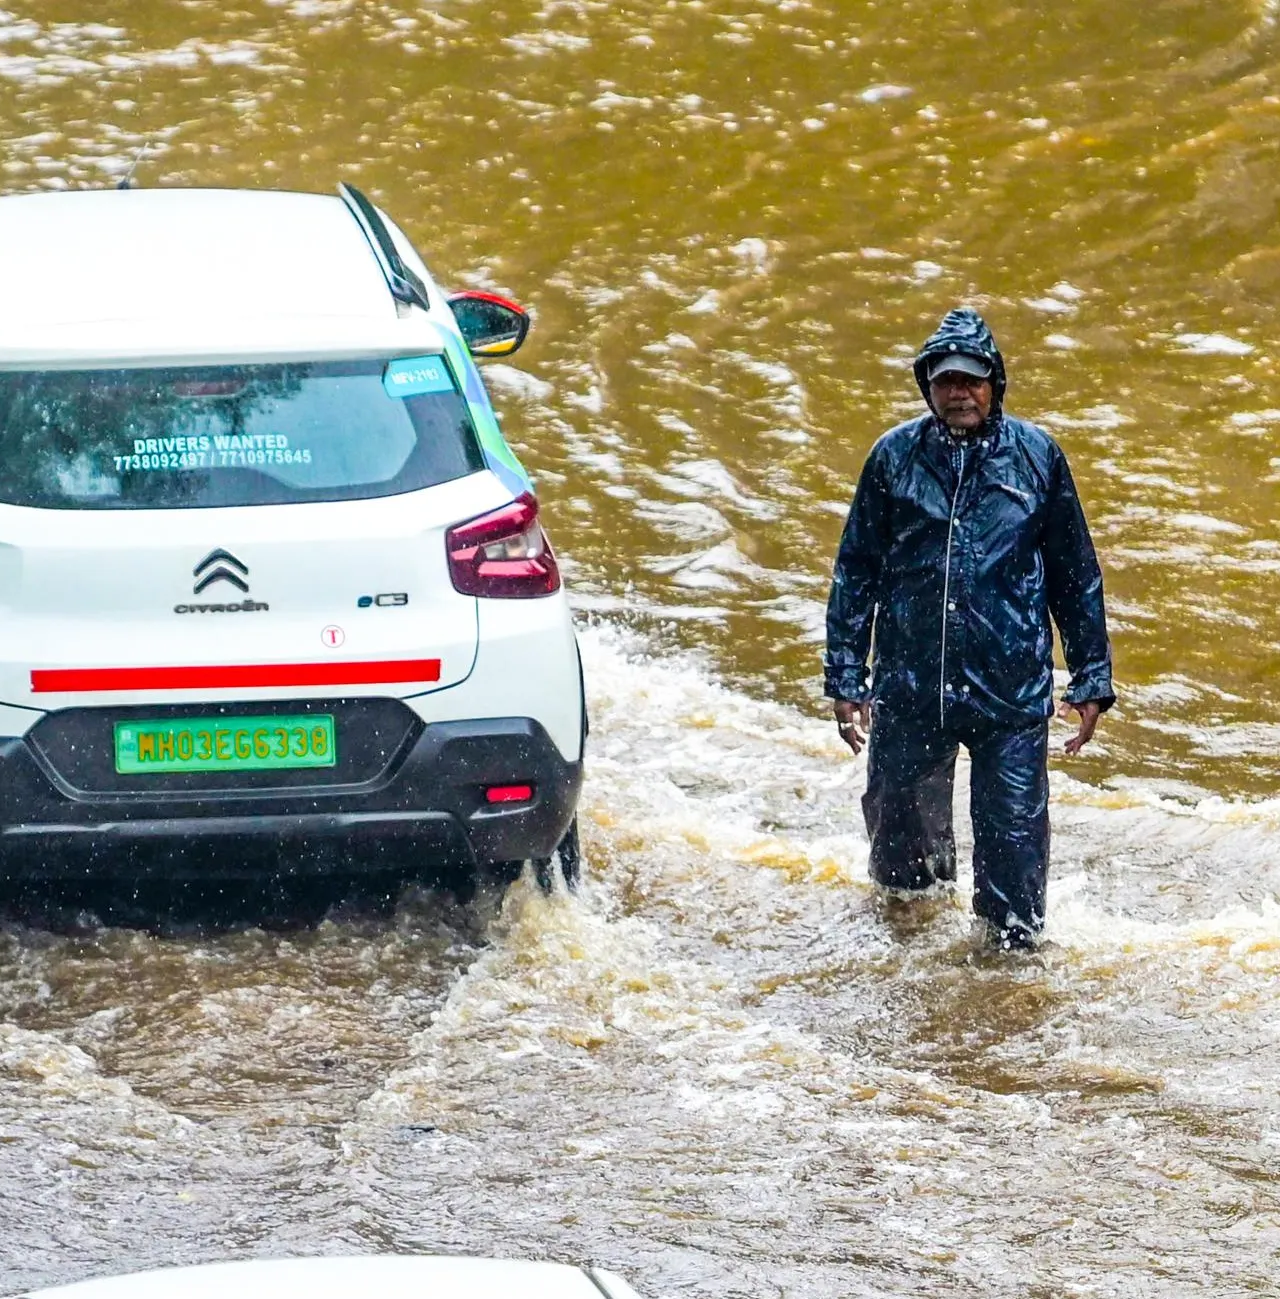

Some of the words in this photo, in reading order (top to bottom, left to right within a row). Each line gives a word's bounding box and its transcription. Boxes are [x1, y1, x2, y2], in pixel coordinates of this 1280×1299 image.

[134, 436, 210, 454] DRIVERS
[213, 434, 288, 450] WANTED
[114, 452, 206, 470] 7738092497
[219, 450, 312, 465] 7710975645
[327, 629, 340, 644] T
[137, 725, 328, 762] MH03EG6338
